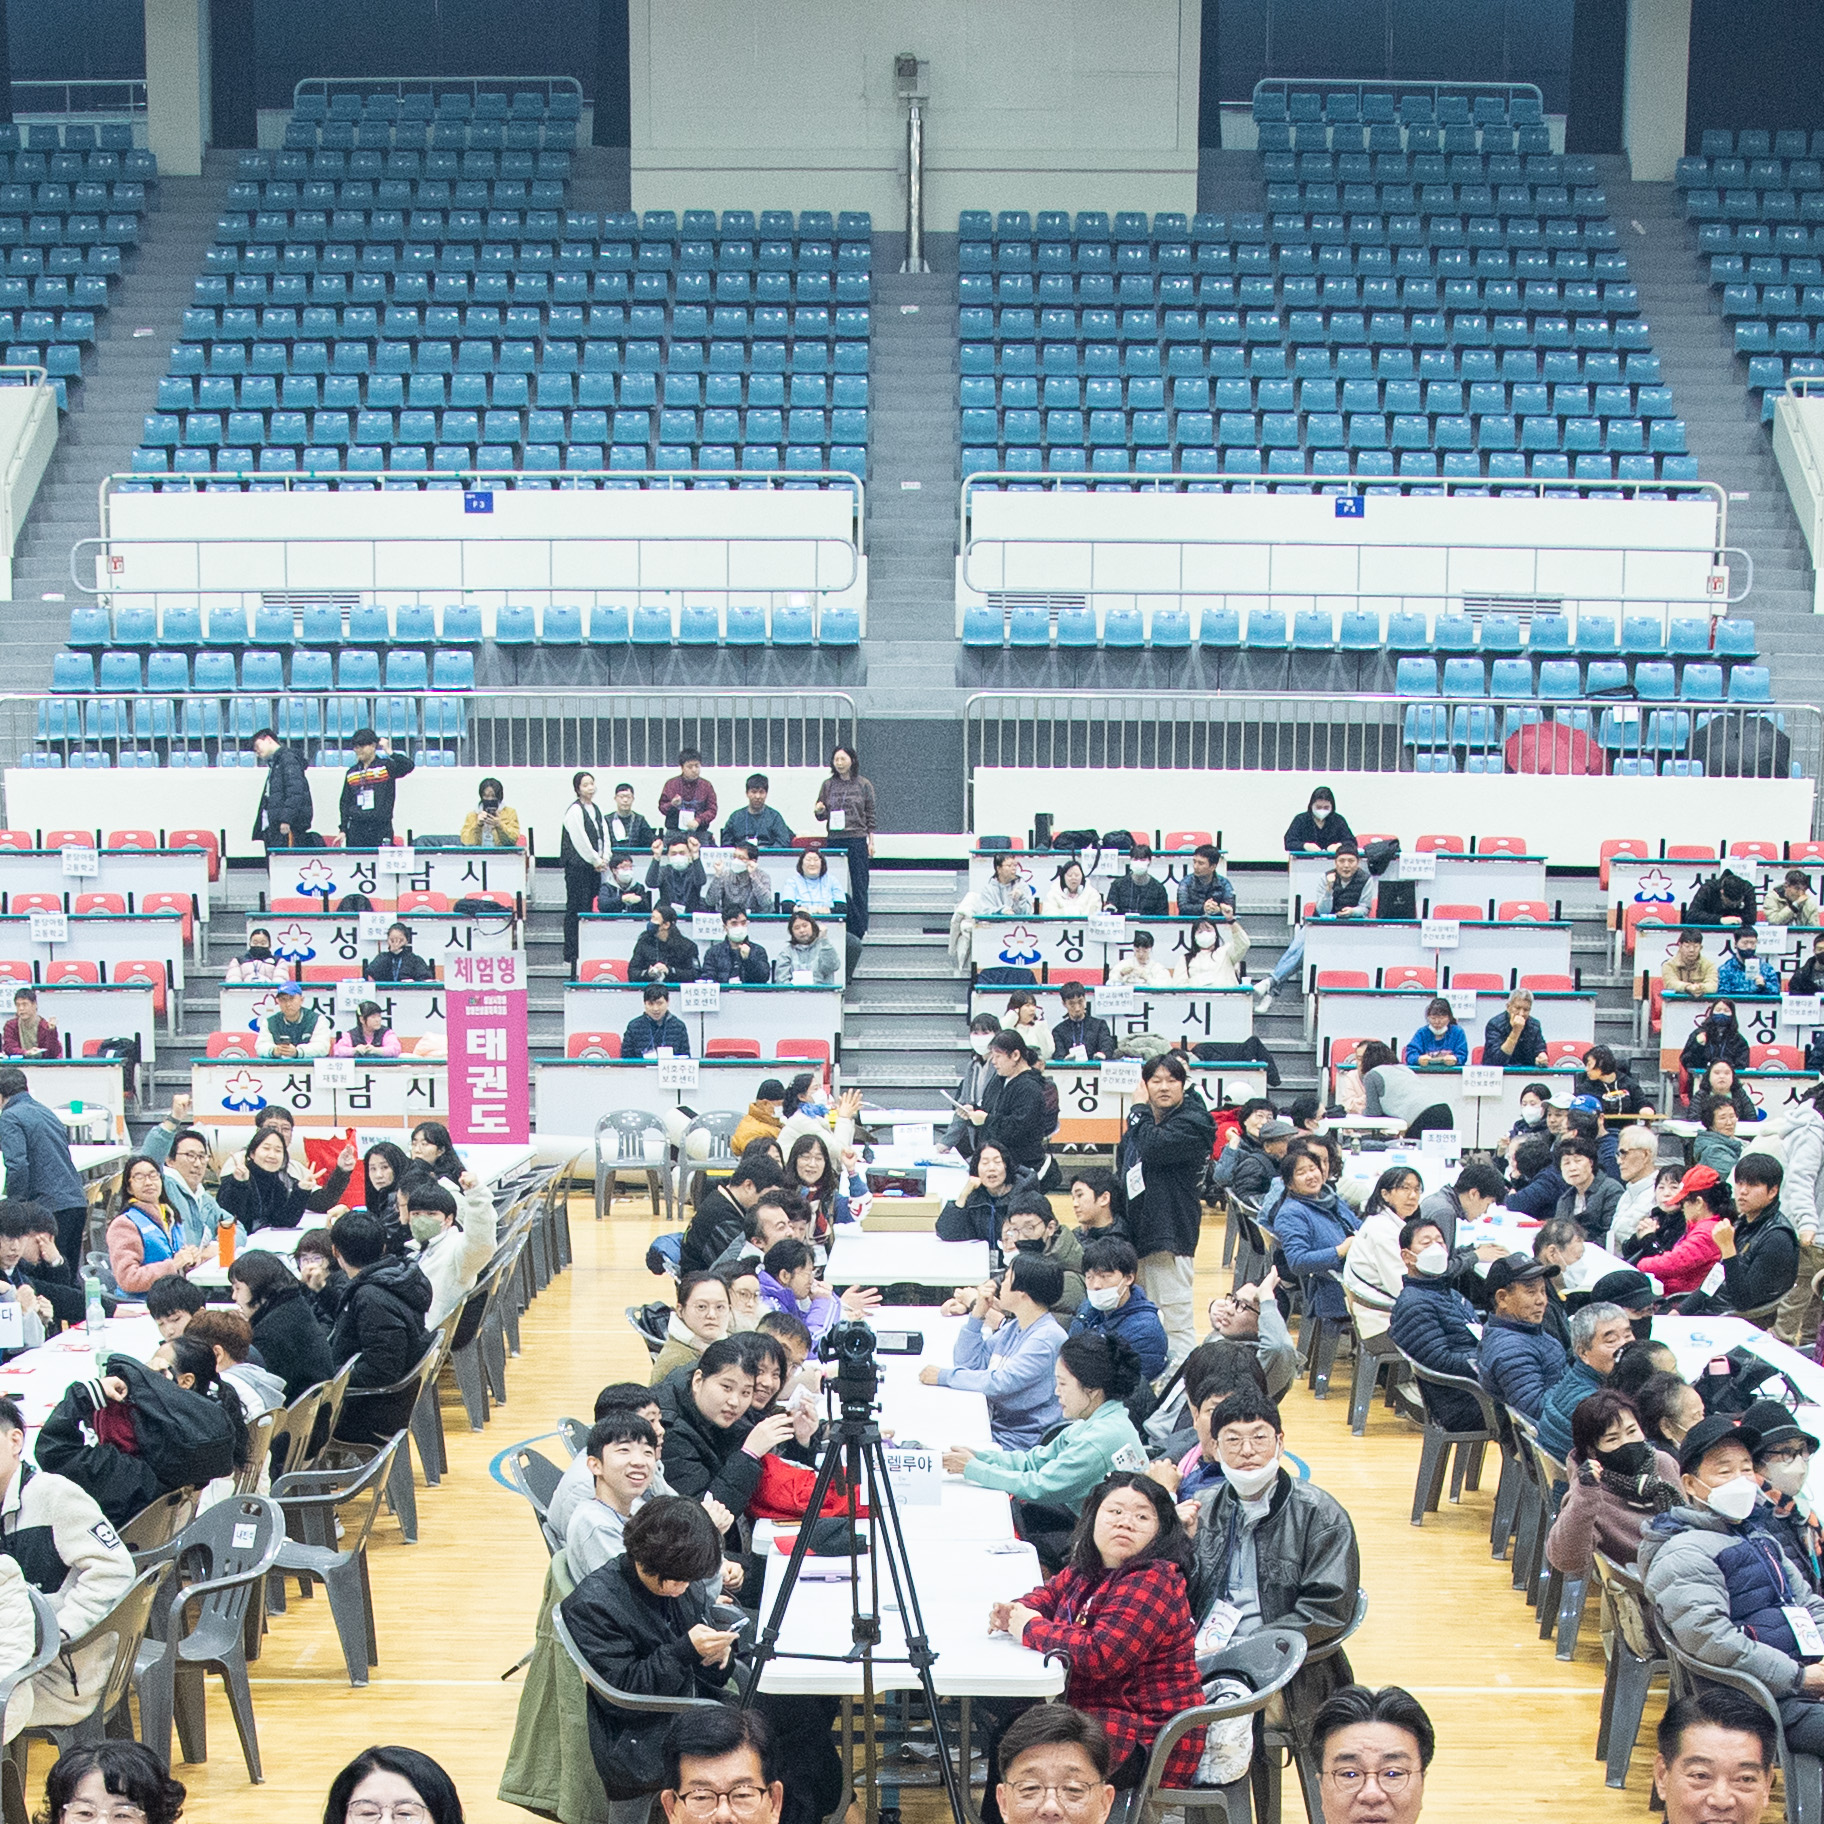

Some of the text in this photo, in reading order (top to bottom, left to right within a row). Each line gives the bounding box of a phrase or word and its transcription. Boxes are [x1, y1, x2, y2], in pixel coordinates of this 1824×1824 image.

[34, 929, 64, 937] 고등학교
[454, 956, 516, 984] 체험형
[684, 988, 717, 997] 서호주간
[685, 998, 717, 1007] 보호센터
[661, 1065, 696, 1074] 서호주간
[465, 1028, 511, 1134] 태권도
[662, 1075, 696, 1084] 보호센터
[282, 1073, 435, 1109] 성남시
